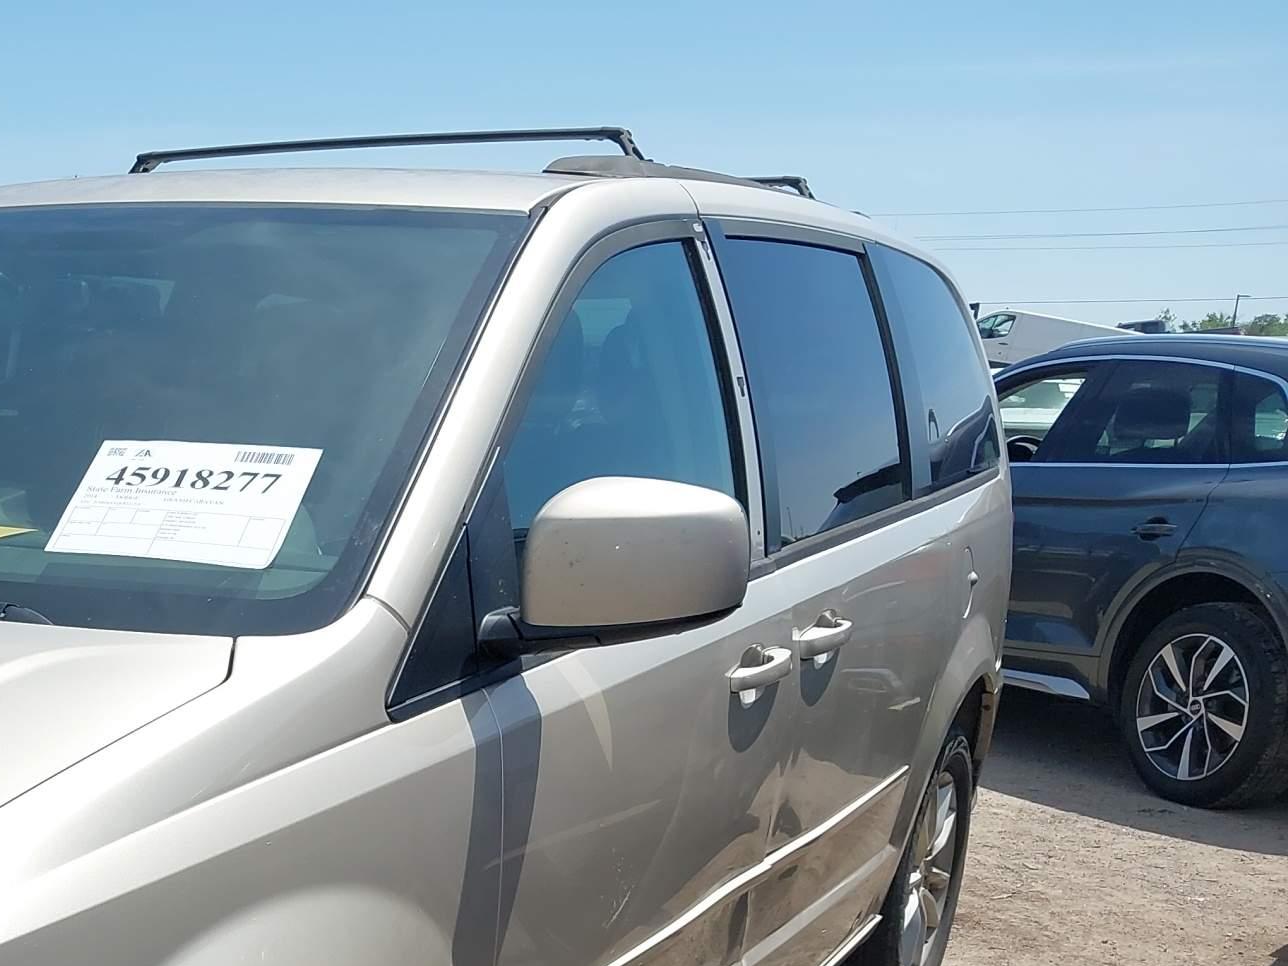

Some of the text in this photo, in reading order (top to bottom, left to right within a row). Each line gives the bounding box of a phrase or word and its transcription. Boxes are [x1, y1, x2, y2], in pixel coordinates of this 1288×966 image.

[105, 465, 283, 495] 45918277
[86, 485, 178, 496] State Farm Insurance
